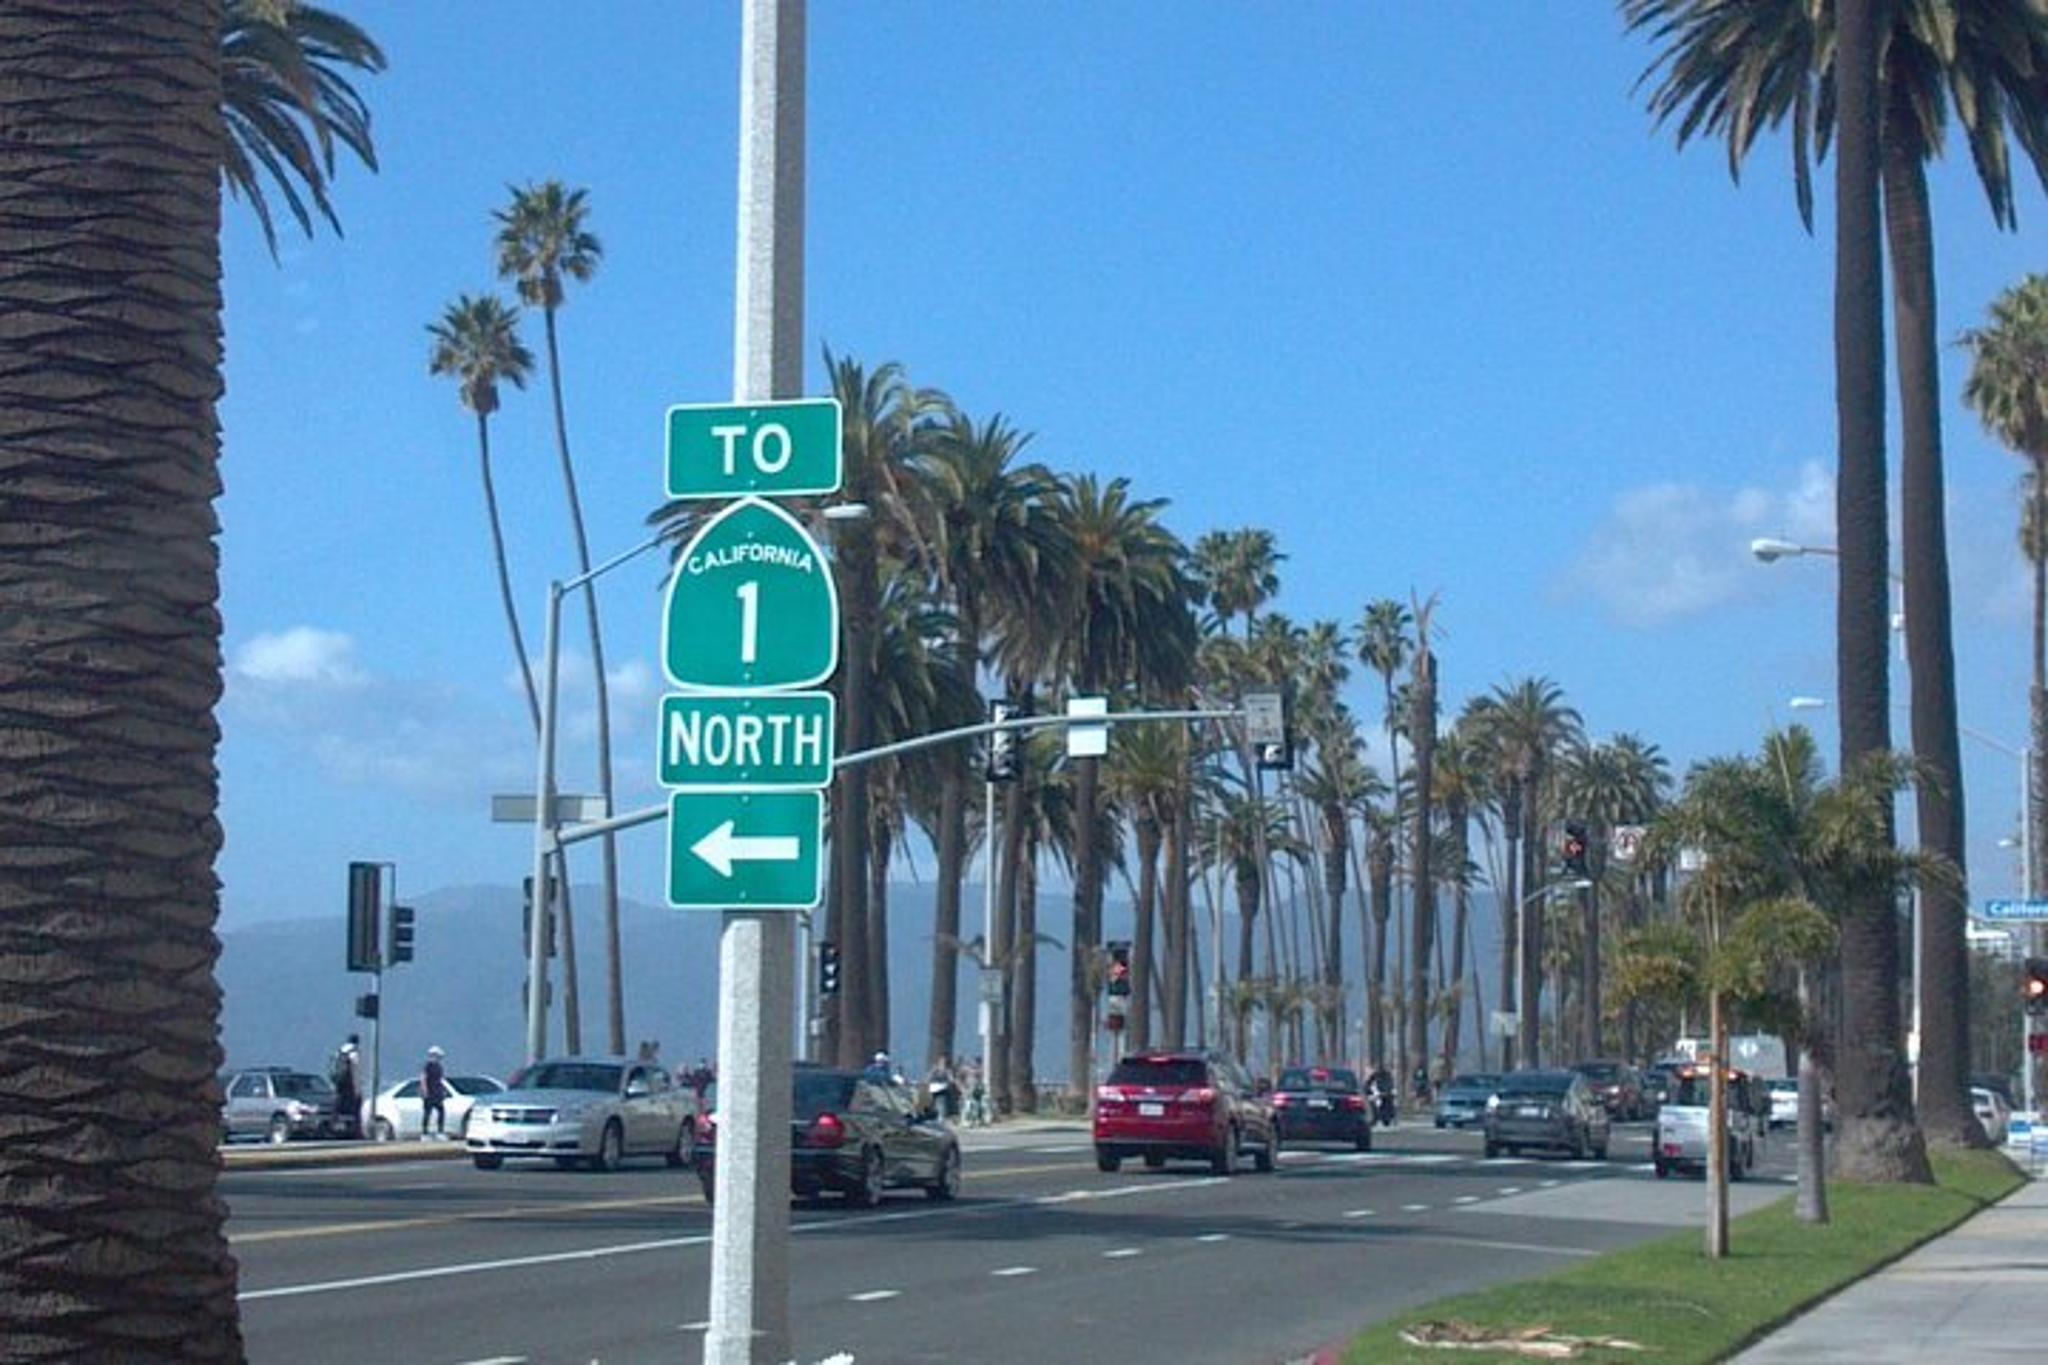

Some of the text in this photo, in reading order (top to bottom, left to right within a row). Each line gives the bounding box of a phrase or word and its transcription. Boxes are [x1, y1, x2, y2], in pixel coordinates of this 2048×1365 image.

[711, 423, 792, 475] TO
[687, 542, 813, 575] CALIFORNIA
[736, 581, 759, 663] 1
[669, 710, 823, 766] NORTH
